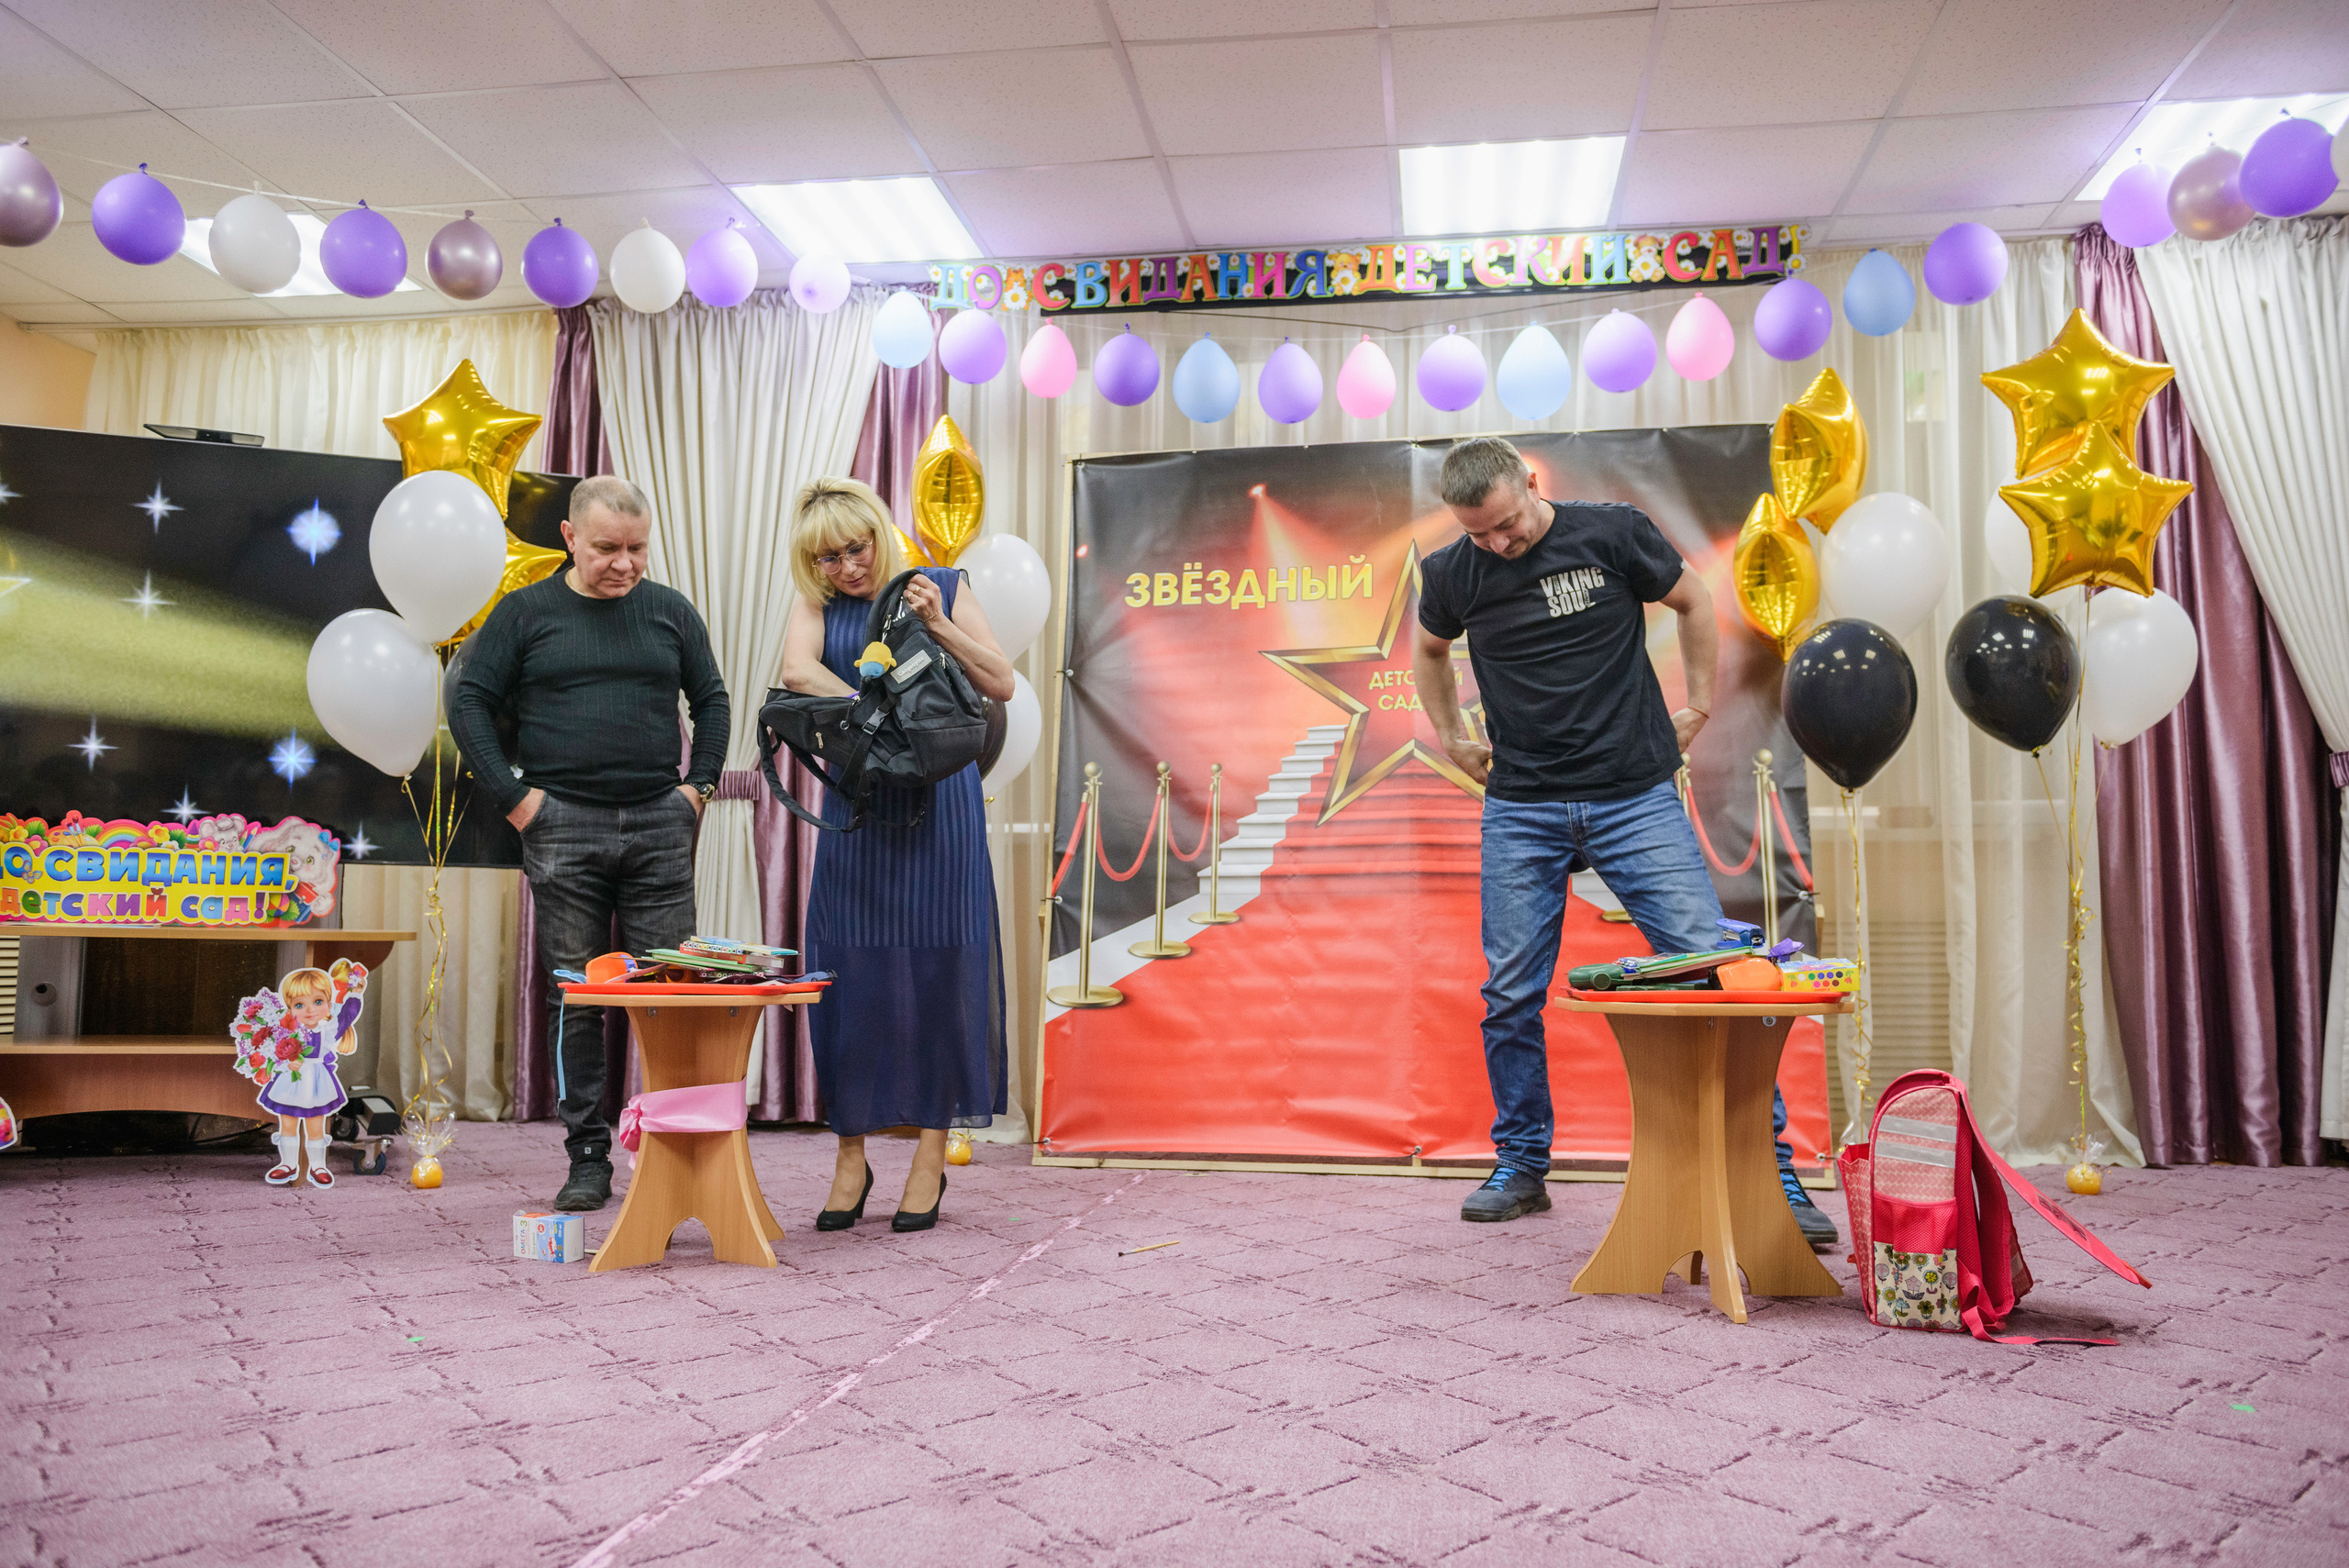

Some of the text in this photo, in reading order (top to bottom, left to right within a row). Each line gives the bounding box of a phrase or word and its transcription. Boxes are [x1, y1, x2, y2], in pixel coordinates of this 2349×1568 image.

[929, 262, 1003, 310] ДО
[1032, 249, 1328, 310] СВИДАНИЯ
[1360, 232, 1633, 294] ДЕТСКИЙ
[1124, 553, 1374, 610] ЗВЁЗДНЫЙ
[1539, 566, 1606, 597] VIKING
[1547, 588, 1597, 617] SOUL
[1377, 693, 1425, 713] САД
[0, 846, 296, 891] О СВИДАНИЯ,
